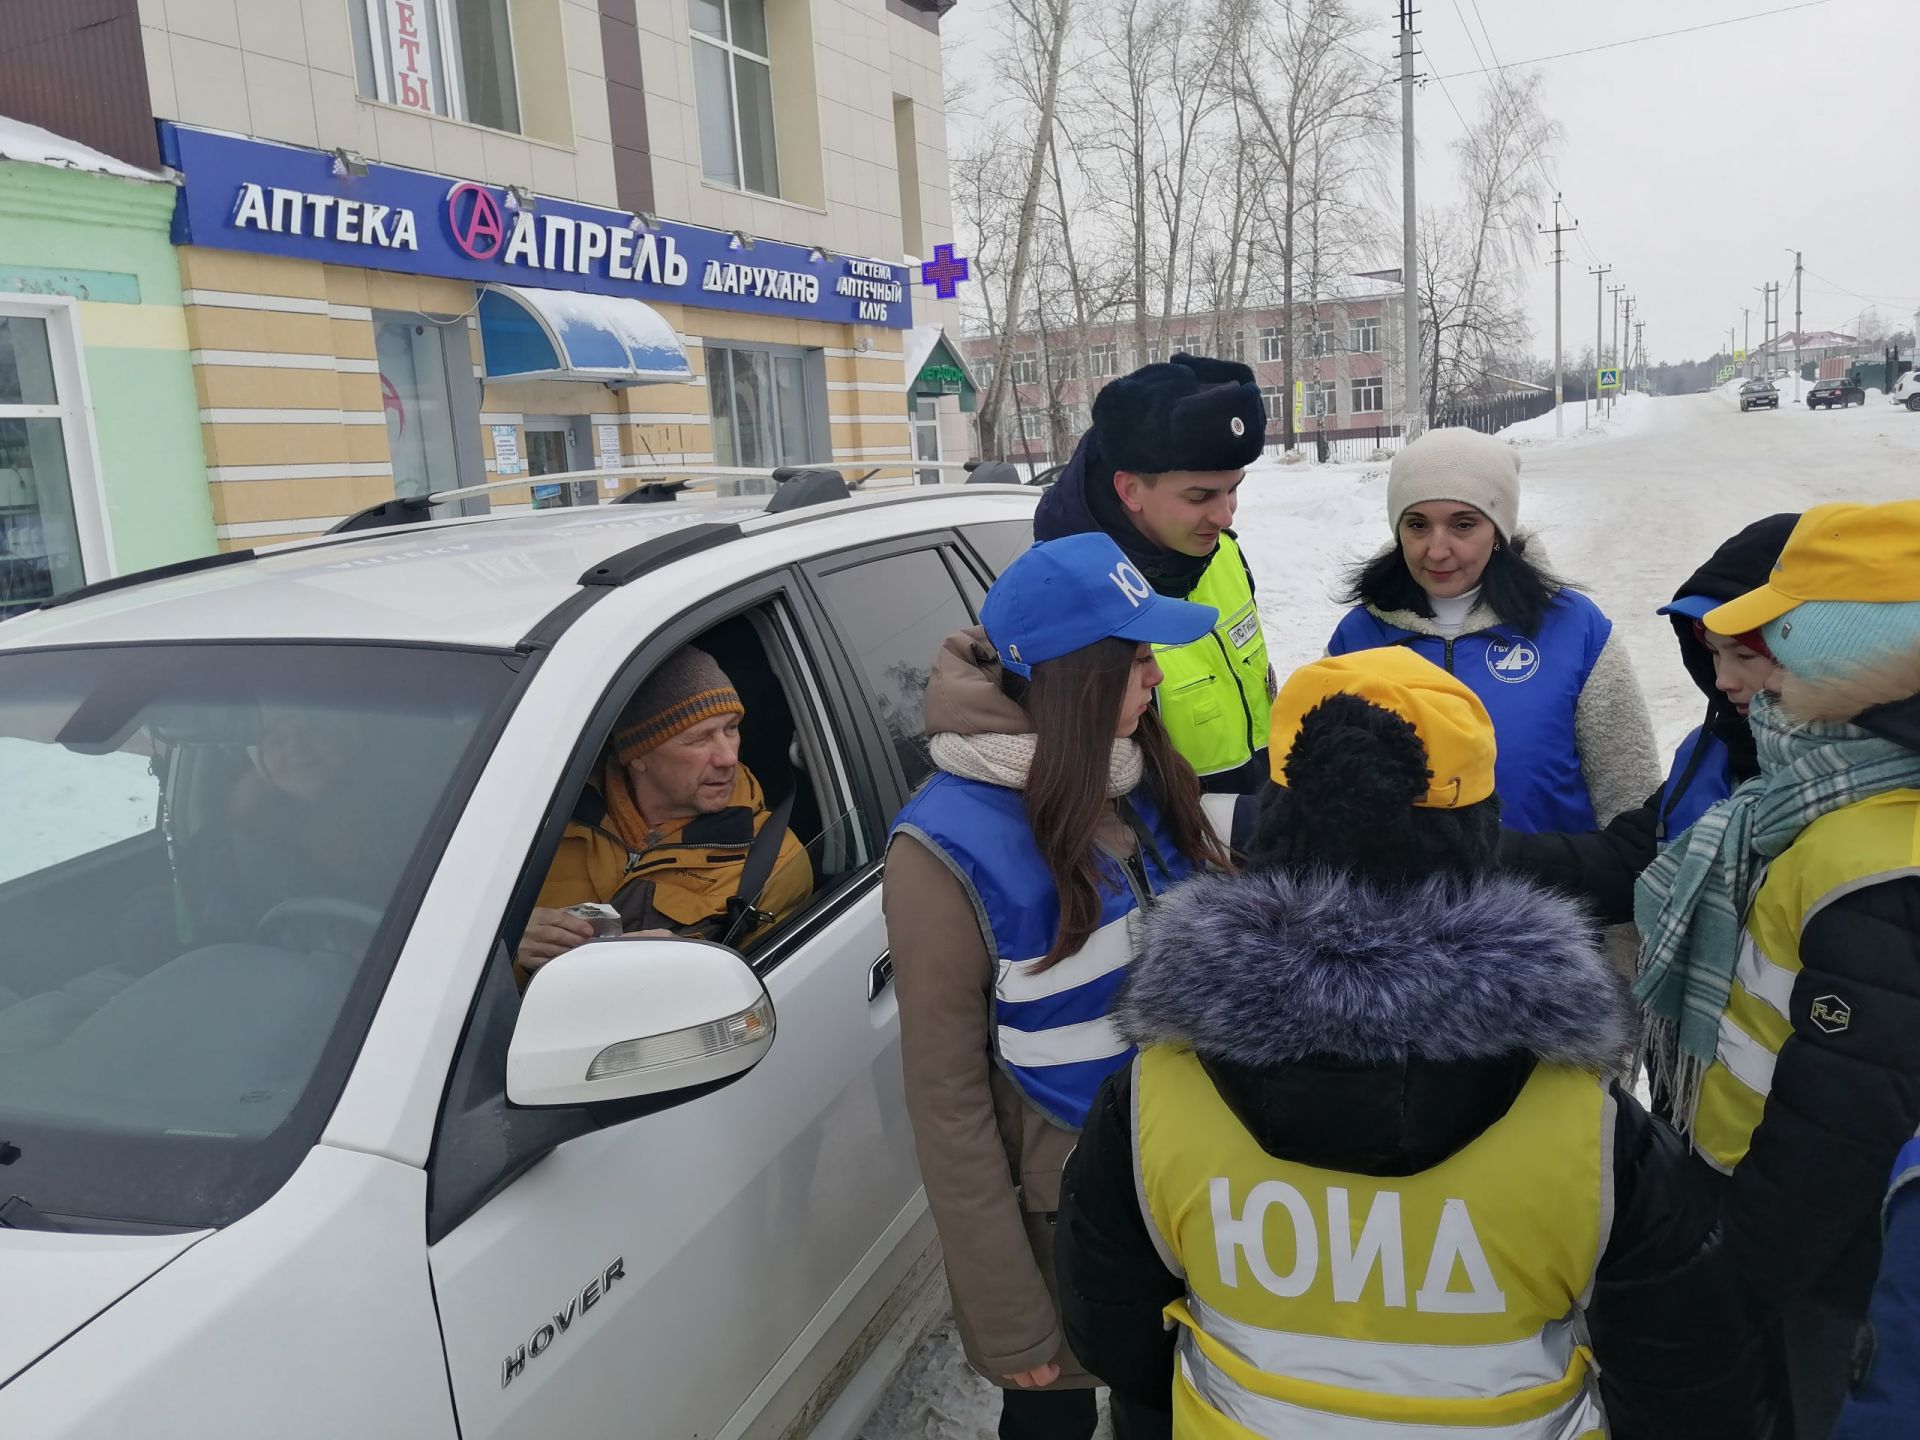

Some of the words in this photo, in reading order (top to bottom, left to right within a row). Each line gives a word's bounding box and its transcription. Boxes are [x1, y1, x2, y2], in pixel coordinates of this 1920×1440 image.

[395, 0, 431, 111] ЕТЫ
[234, 182, 418, 251] АПТЕКА
[503, 211, 688, 286] АПРЕЛЬ
[849, 260, 891, 281] СИСТЕМА
[837, 277, 902, 303] АПТЕЧНЫЙ
[859, 301, 887, 321] КЛУБ
[1209, 1177, 1506, 1313] ЮИД
[502, 1256, 626, 1389] HOVER
